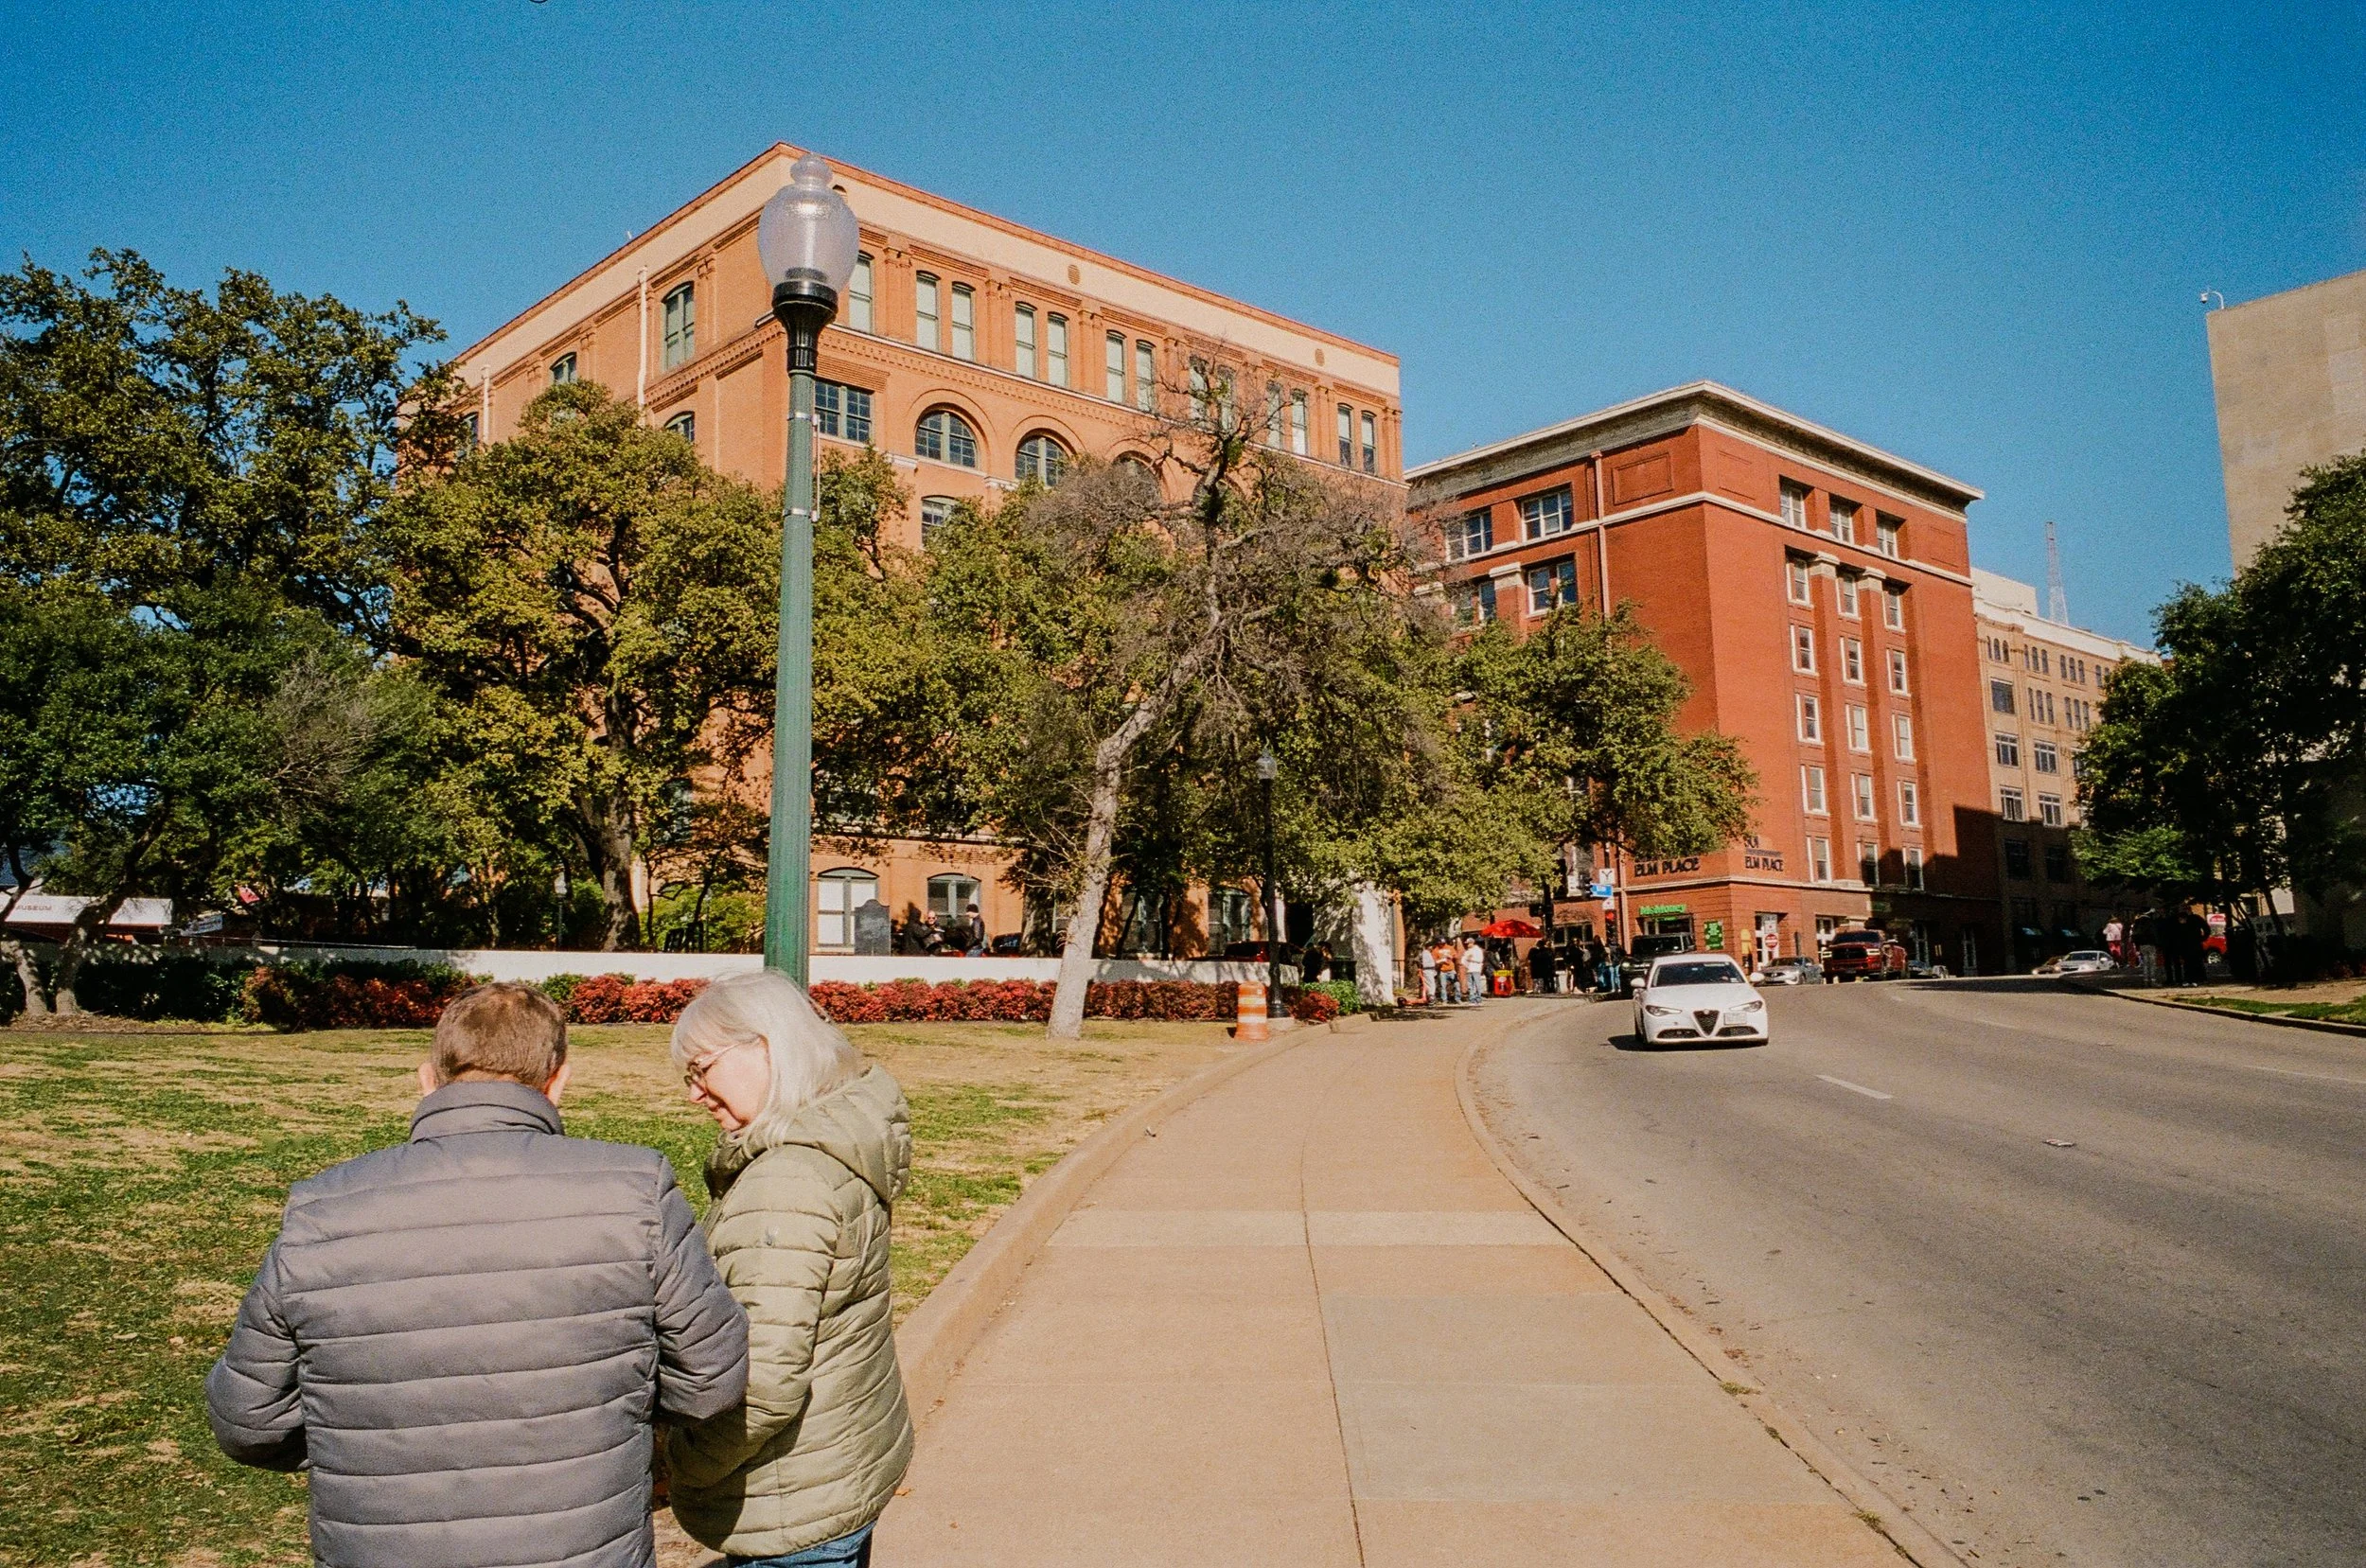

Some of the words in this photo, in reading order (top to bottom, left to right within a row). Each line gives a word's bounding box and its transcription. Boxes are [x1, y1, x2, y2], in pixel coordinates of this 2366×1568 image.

[1634, 862, 1658, 877] ELM
[1662, 856, 1701, 874] PLACE
[1745, 855, 1760, 870] ELM
[1762, 857, 1784, 872] PLACE
